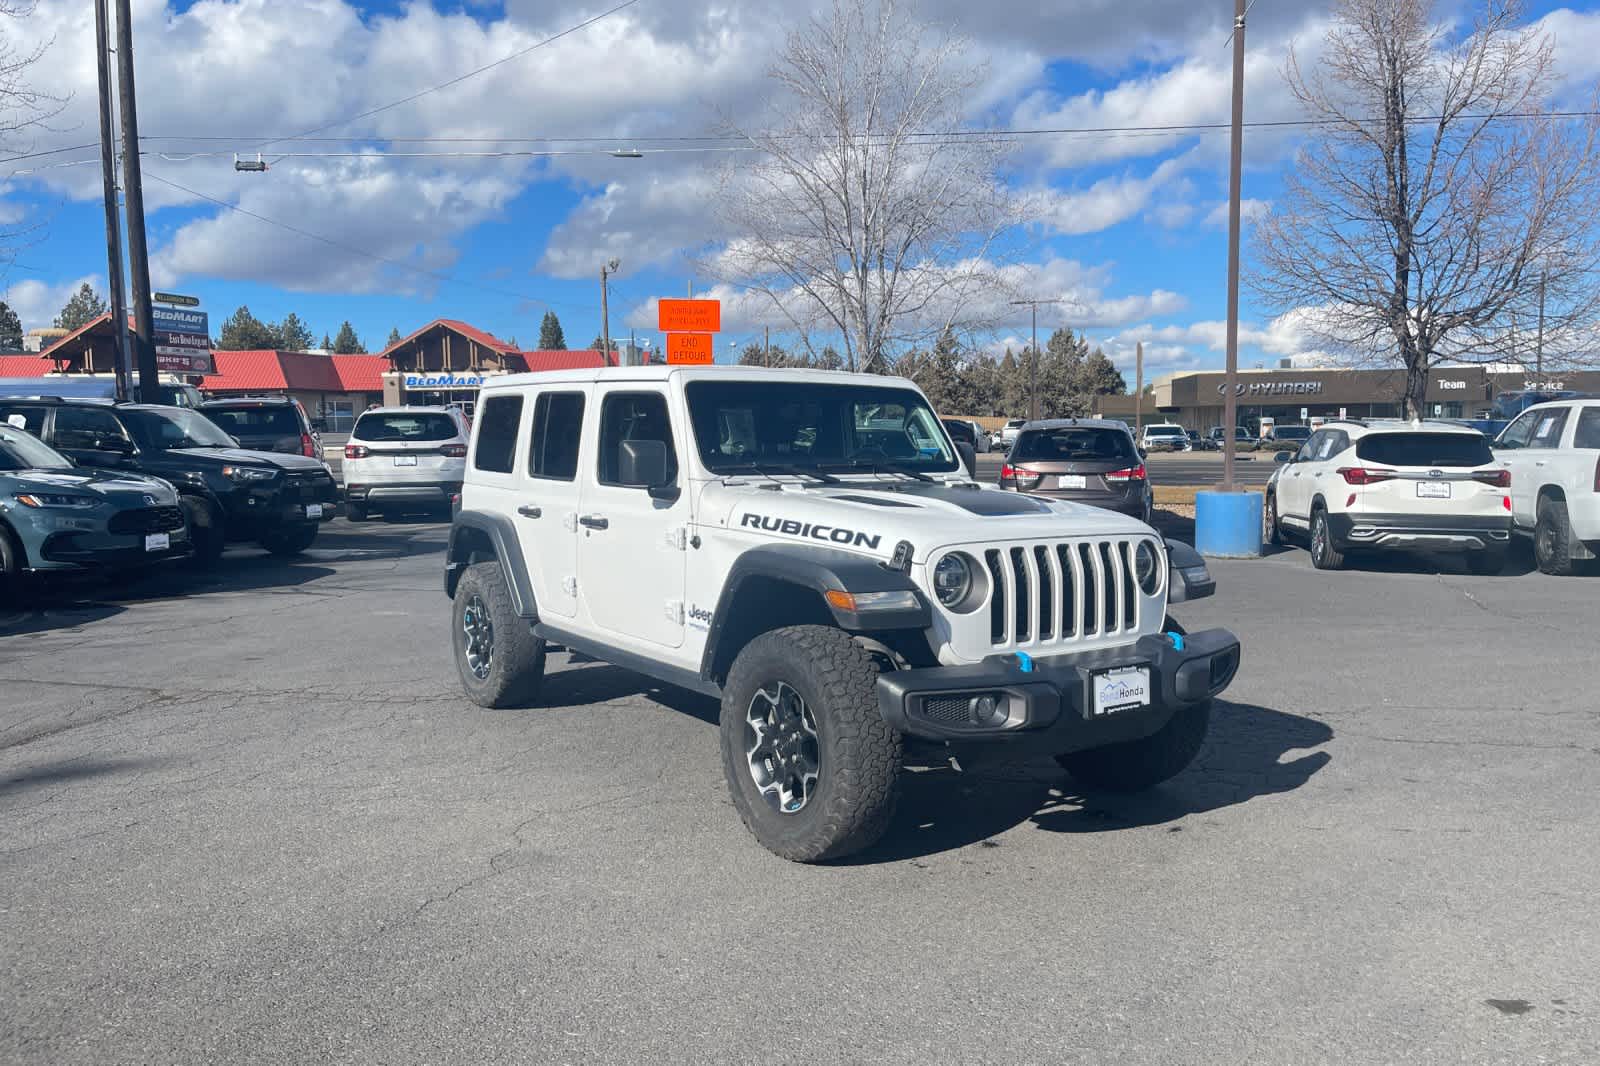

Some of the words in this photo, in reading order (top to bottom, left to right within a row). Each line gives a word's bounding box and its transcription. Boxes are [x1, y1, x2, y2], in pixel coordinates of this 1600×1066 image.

[680, 335, 698, 348] END
[673, 350, 706, 361] DETOUR
[1249, 381, 1322, 395] HYUNDAI
[1437, 379, 1466, 390] Team
[740, 512, 882, 550] RUBICON
[688, 603, 713, 625] Jeep
